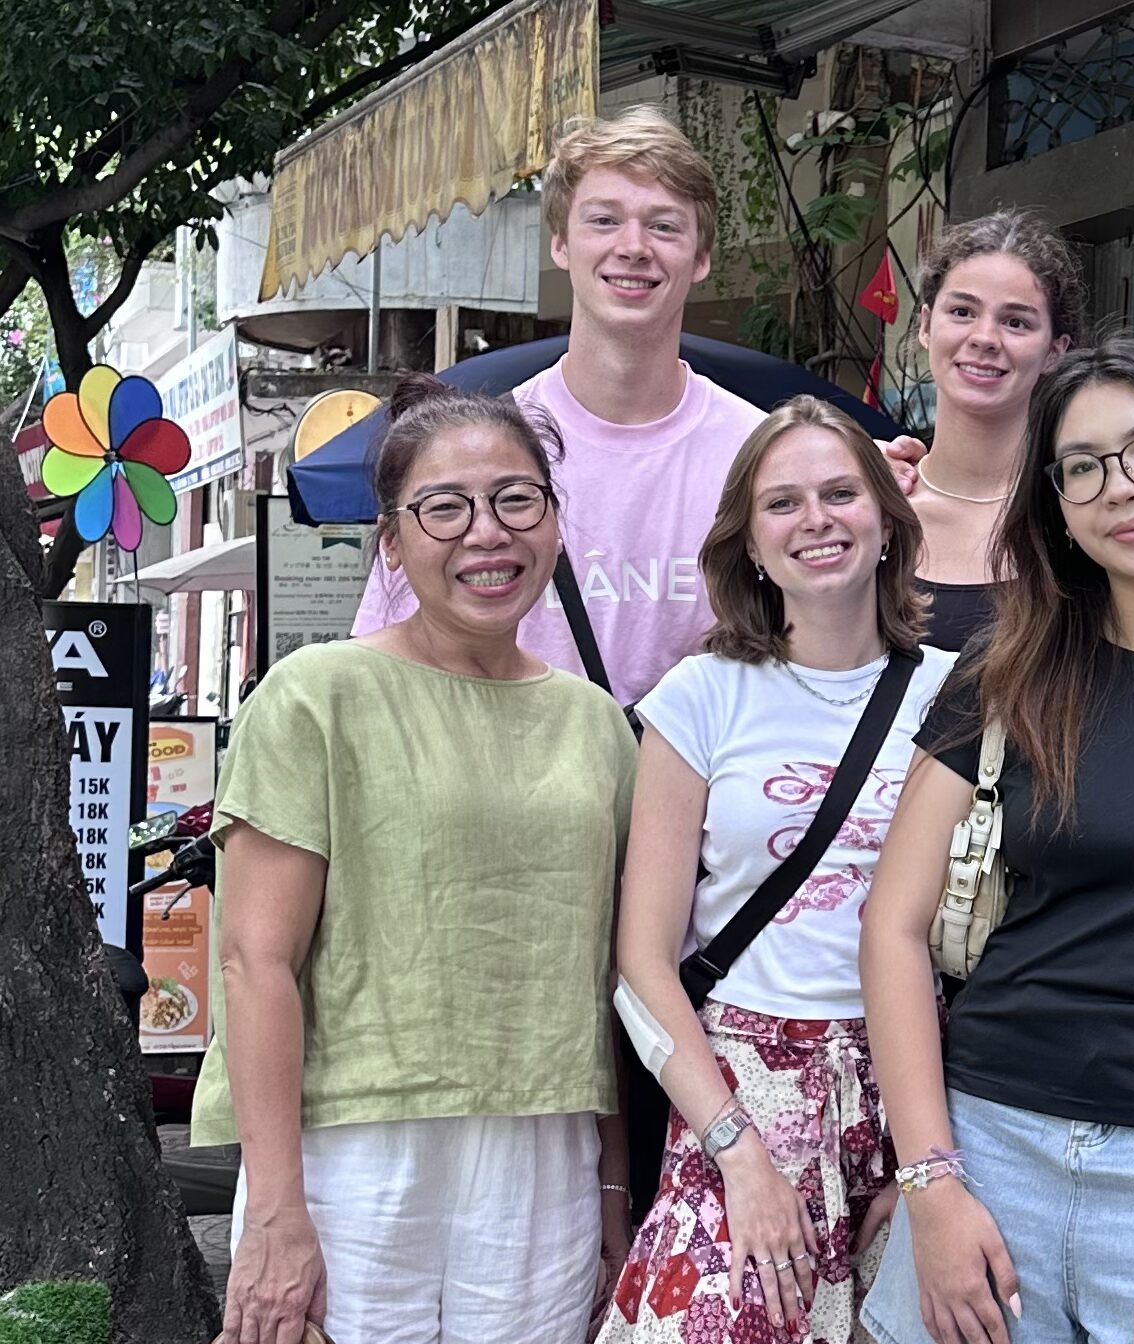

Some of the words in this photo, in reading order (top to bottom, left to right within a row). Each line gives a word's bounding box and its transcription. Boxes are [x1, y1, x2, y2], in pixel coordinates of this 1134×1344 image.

[151, 744, 186, 757] OOD
[79, 778, 110, 795] 15K
[78, 803, 109, 819] 18K
[77, 828, 107, 844] 18K
[85, 878, 105, 894] 5K
